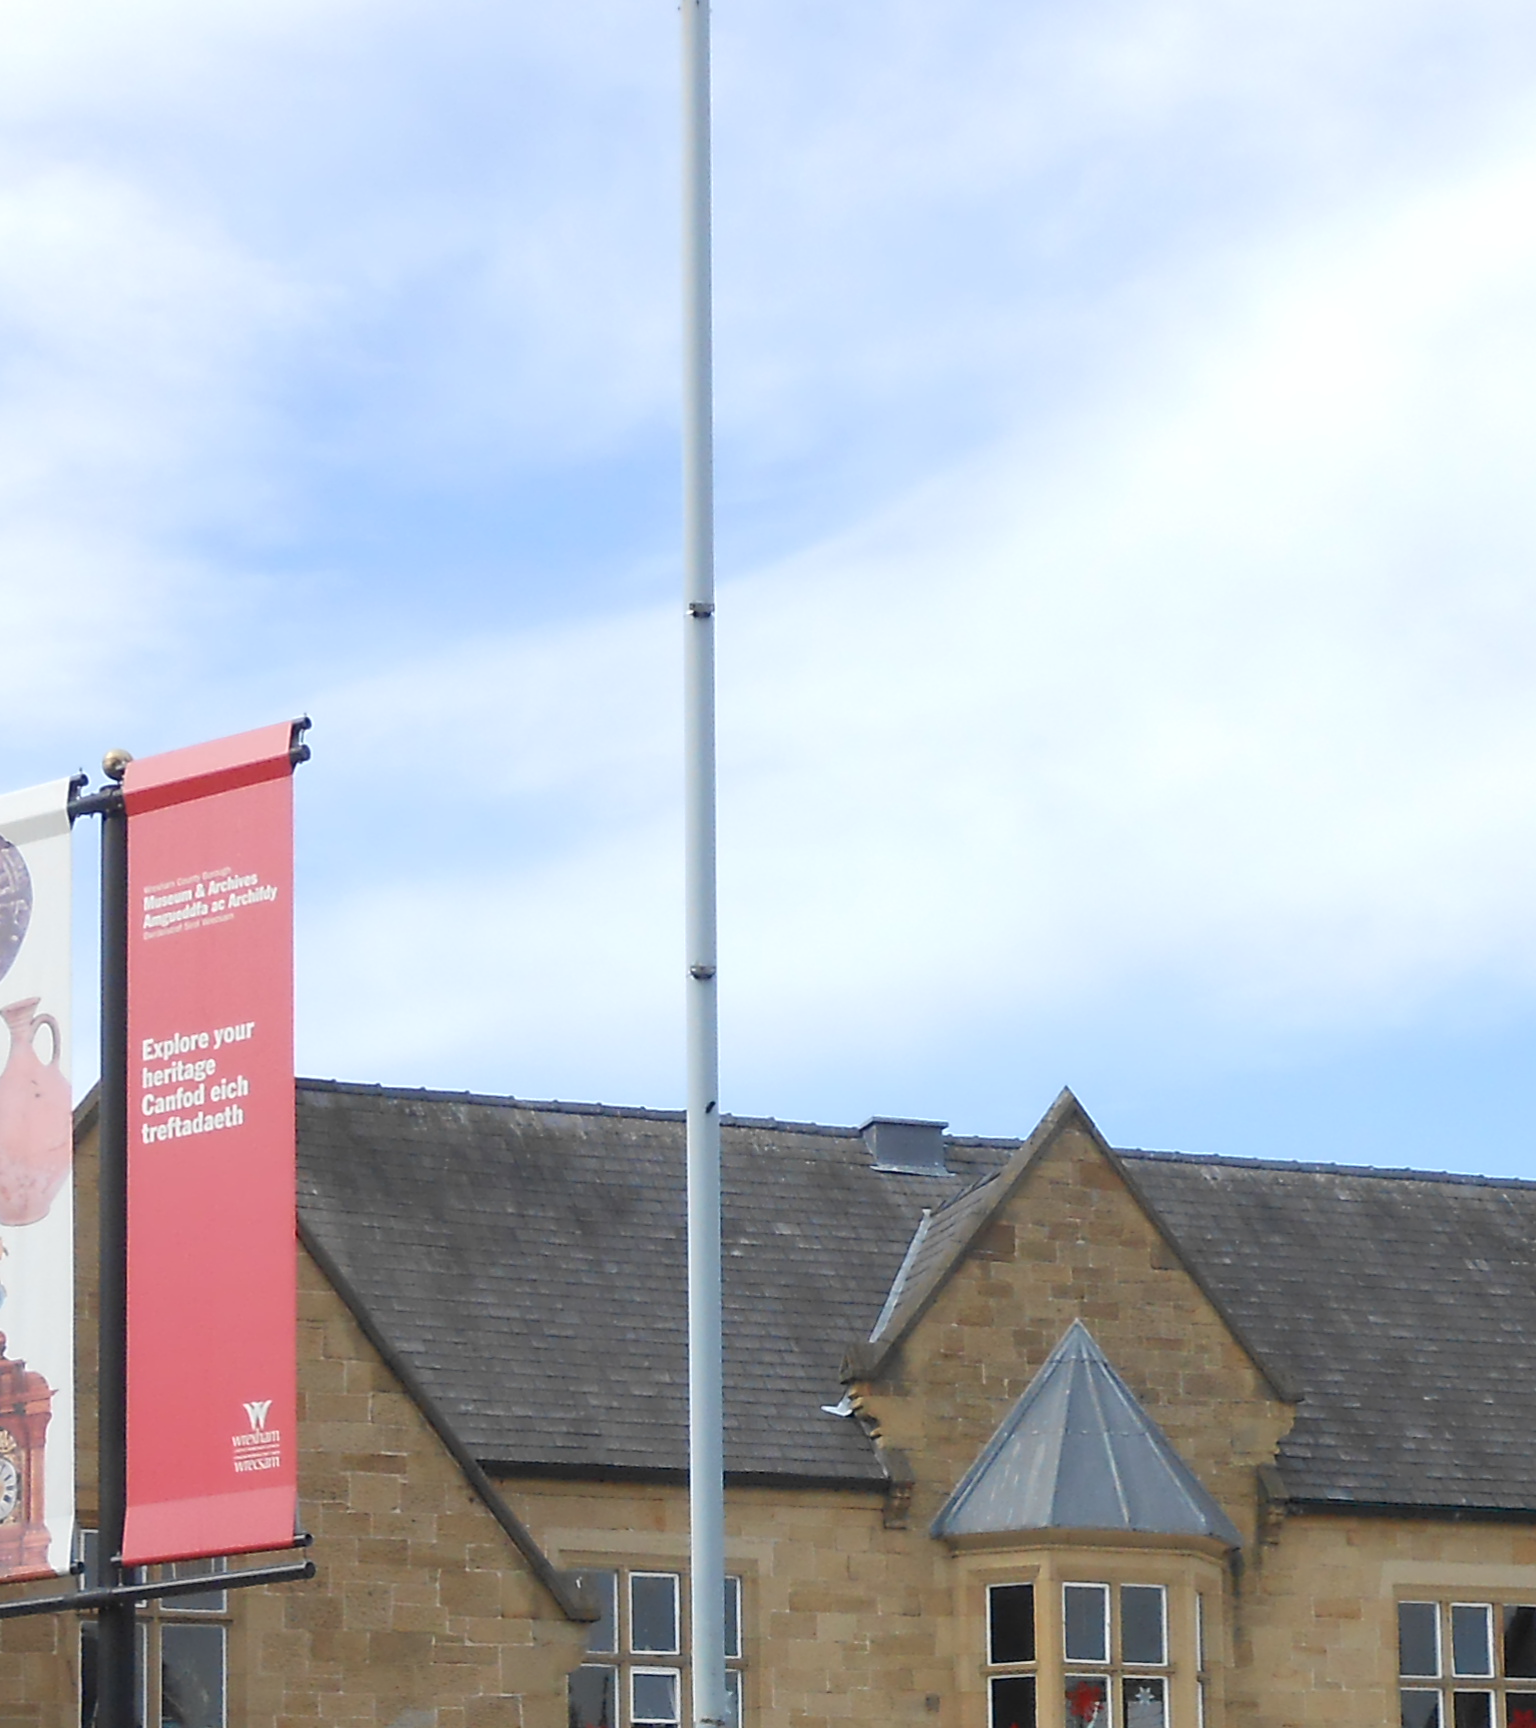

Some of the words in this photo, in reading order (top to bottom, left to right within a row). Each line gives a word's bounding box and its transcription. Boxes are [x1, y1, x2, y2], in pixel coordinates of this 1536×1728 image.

[143, 889, 192, 911] Museum
[194, 883, 206, 899] &
[208, 873, 258, 896] Archives
[211, 899, 225, 913] ac
[142, 1032, 209, 1061] Explore
[213, 1021, 255, 1050] your
[142, 1058, 216, 1089] heritage
[141, 1083, 205, 1116] Canfod
[210, 1075, 249, 1102] eich
[141, 1104, 244, 1144] treftadaeth
